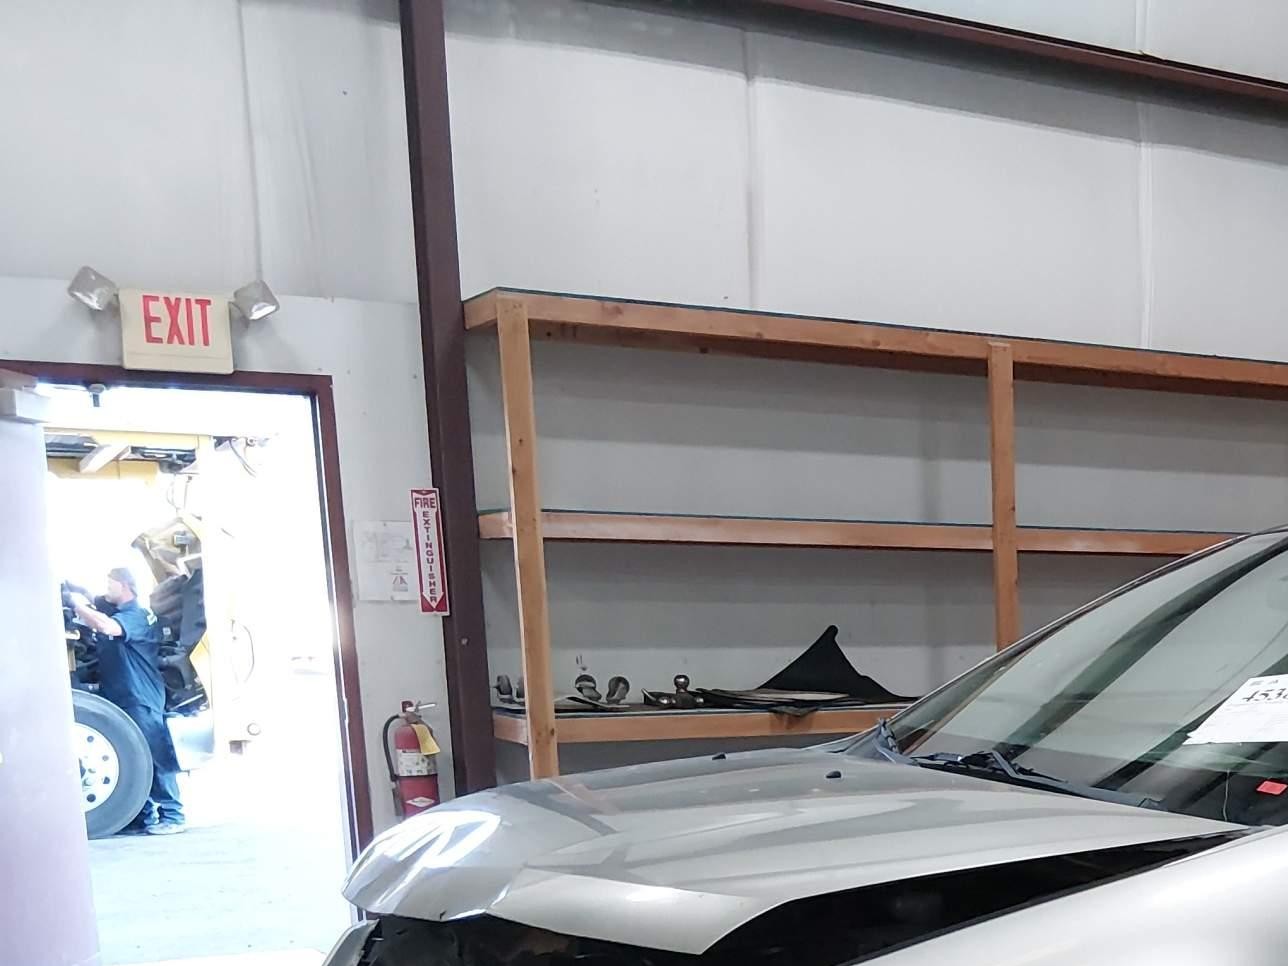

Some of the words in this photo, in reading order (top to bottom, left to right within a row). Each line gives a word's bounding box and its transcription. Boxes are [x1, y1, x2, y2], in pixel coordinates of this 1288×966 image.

[142, 294, 211, 346] EXIT
[414, 497, 436, 509] FIRE
[422, 511, 438, 603] EXTINGUISHER
